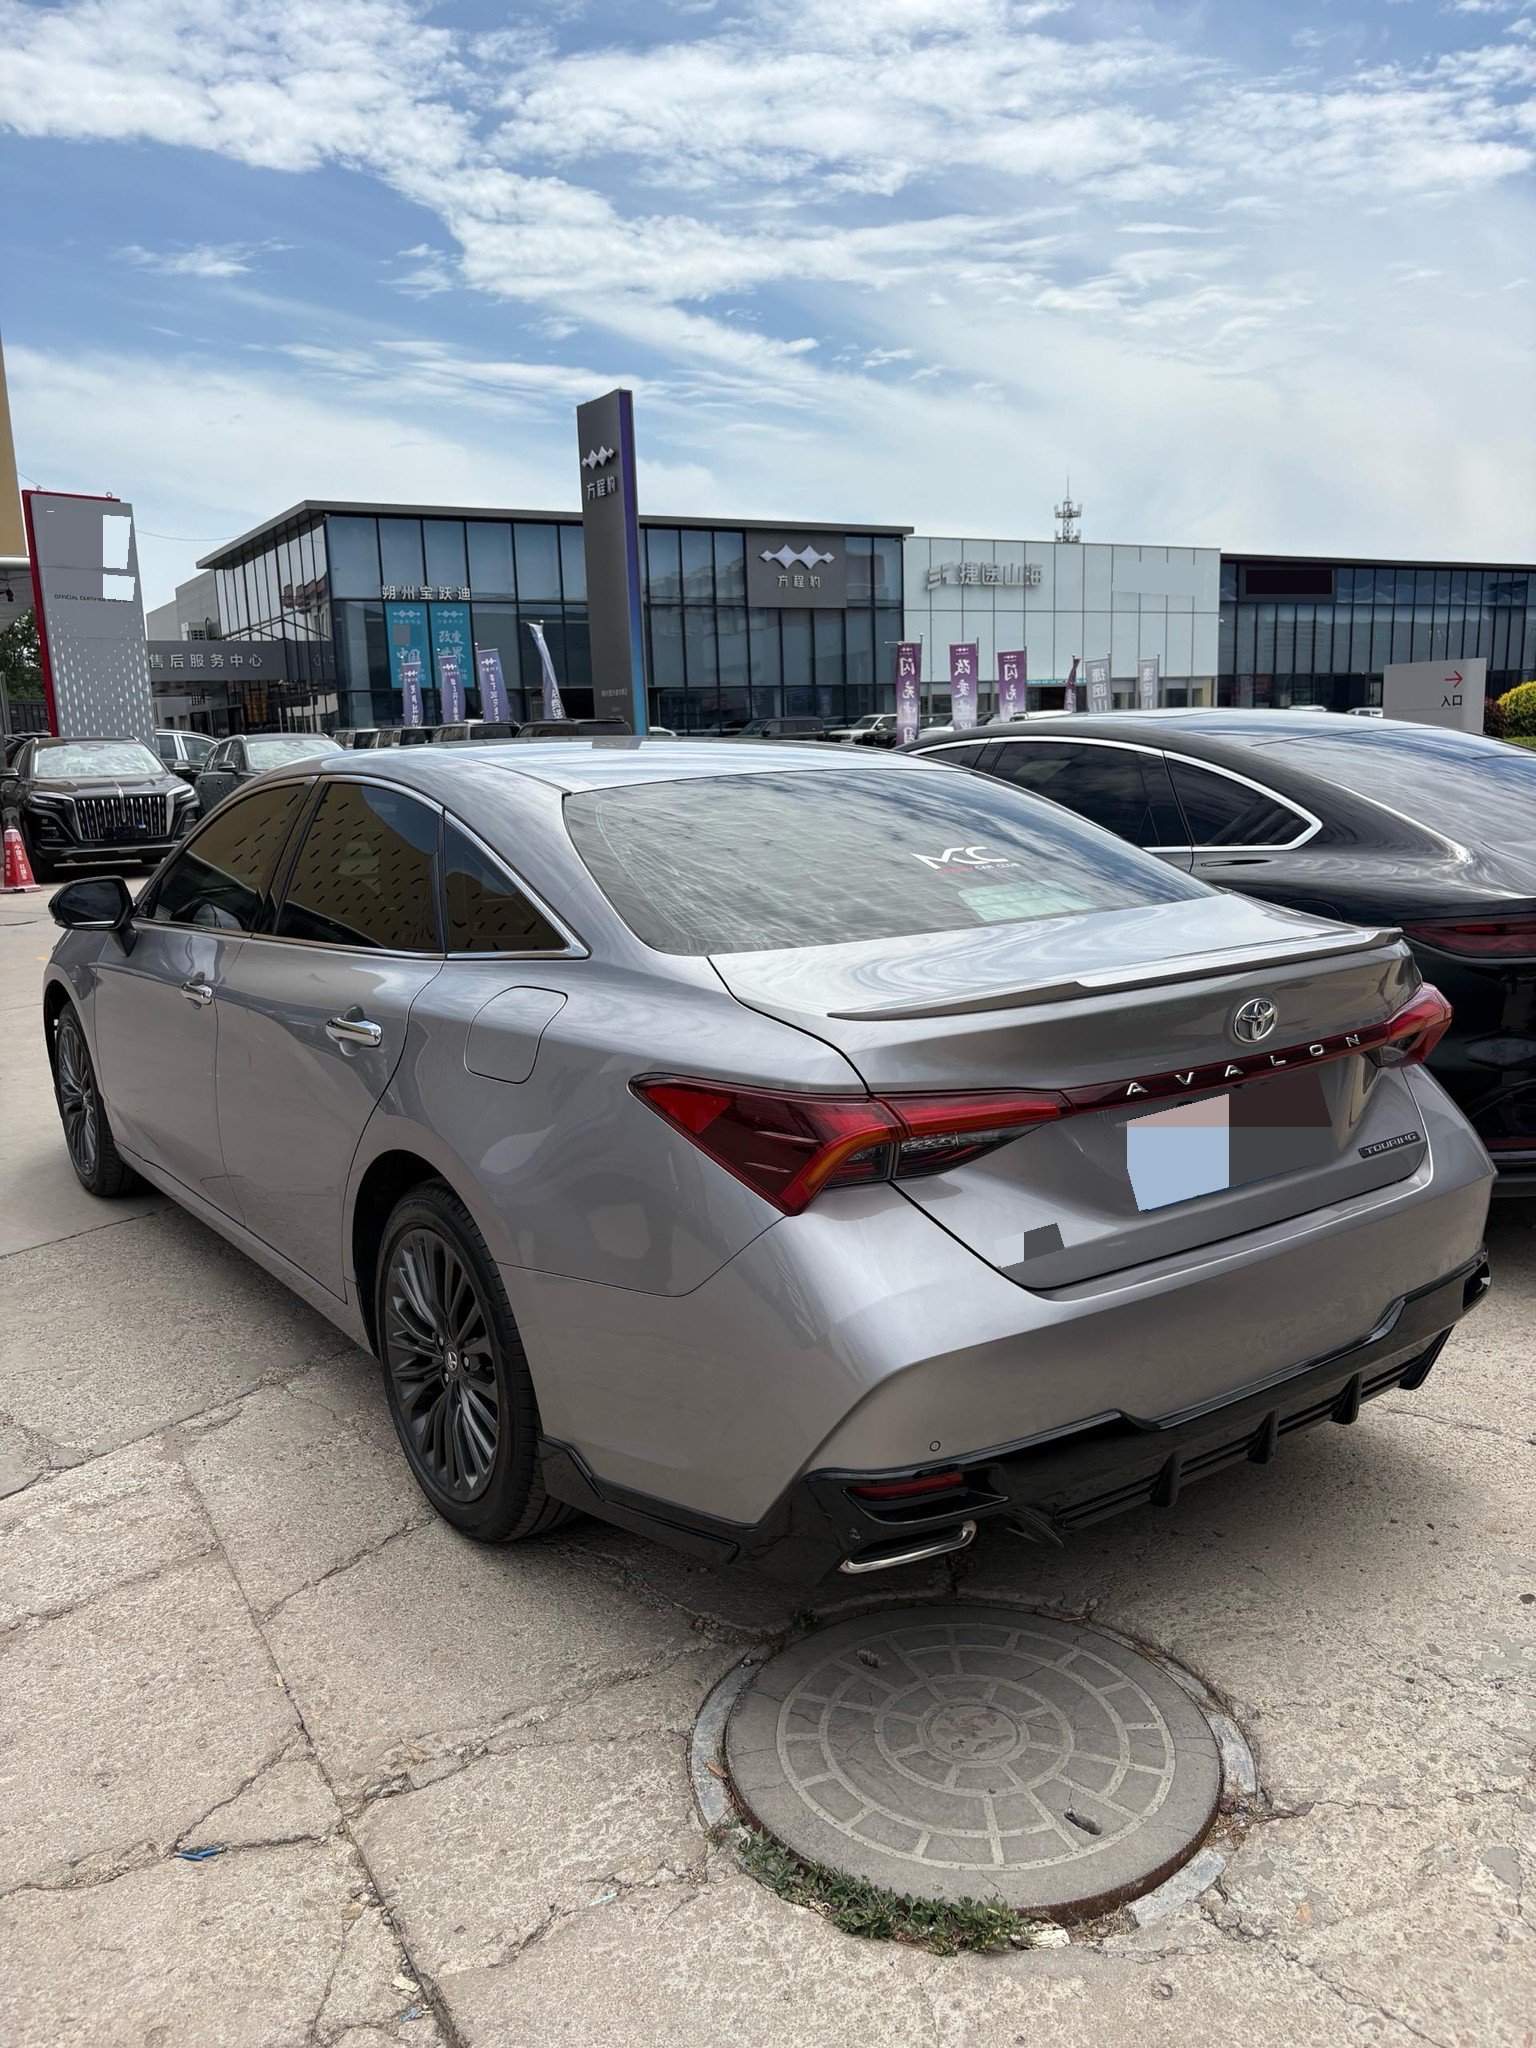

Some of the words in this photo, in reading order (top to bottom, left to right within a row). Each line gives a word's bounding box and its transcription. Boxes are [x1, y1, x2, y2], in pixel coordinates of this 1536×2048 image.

[586, 475, 616, 500] 方程豹
[777, 574, 821, 588] 方程豹
[382, 585, 471, 600] 朔州宝跃迪
[149, 653, 263, 669] 售后服务中心
[1441, 695, 1463, 707] 入口
[1126, 1034, 1361, 1095] AVALON
[1365, 1133, 1417, 1154] TOURING
